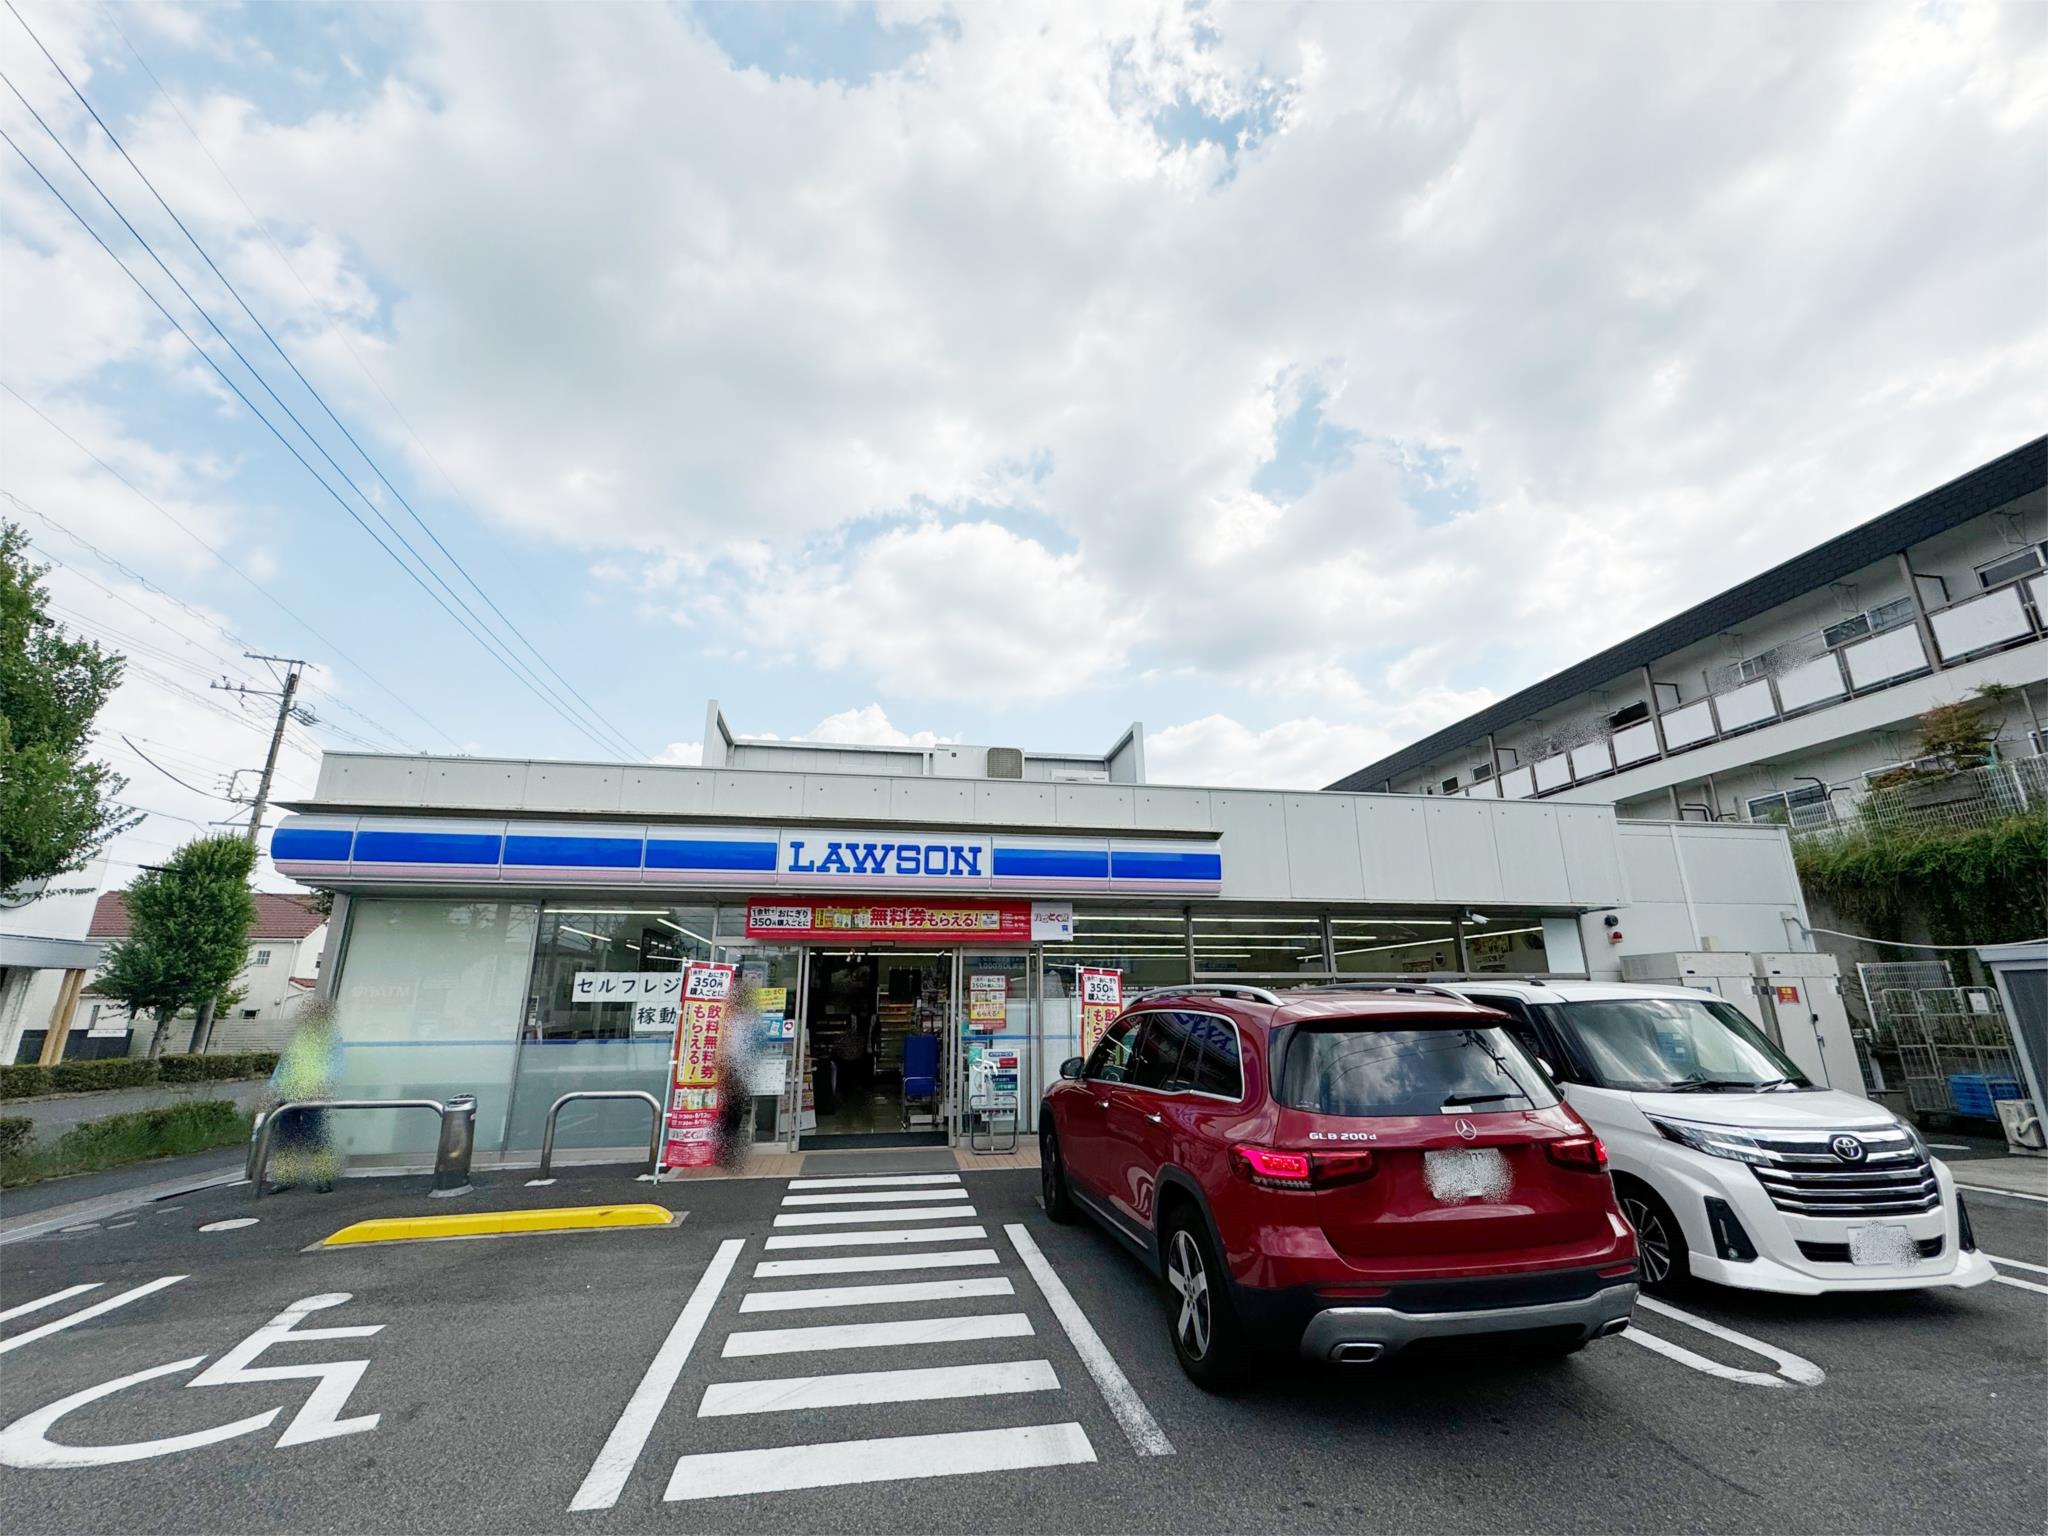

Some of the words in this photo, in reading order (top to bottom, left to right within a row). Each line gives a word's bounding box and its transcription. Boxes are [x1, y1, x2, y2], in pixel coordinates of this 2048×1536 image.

[789, 841, 982, 876] LAWSON
[778, 909, 808, 919] おにぎり
[577, 977, 682, 994] セルフレジ
[694, 976, 724, 989] 350円
[1089, 982, 1114, 993] 350円
[688, 1004, 706, 1080] もらえる!
[700, 1004, 722, 1079] 飲料無料券
[1309, 1132, 1338, 1141] GLB
